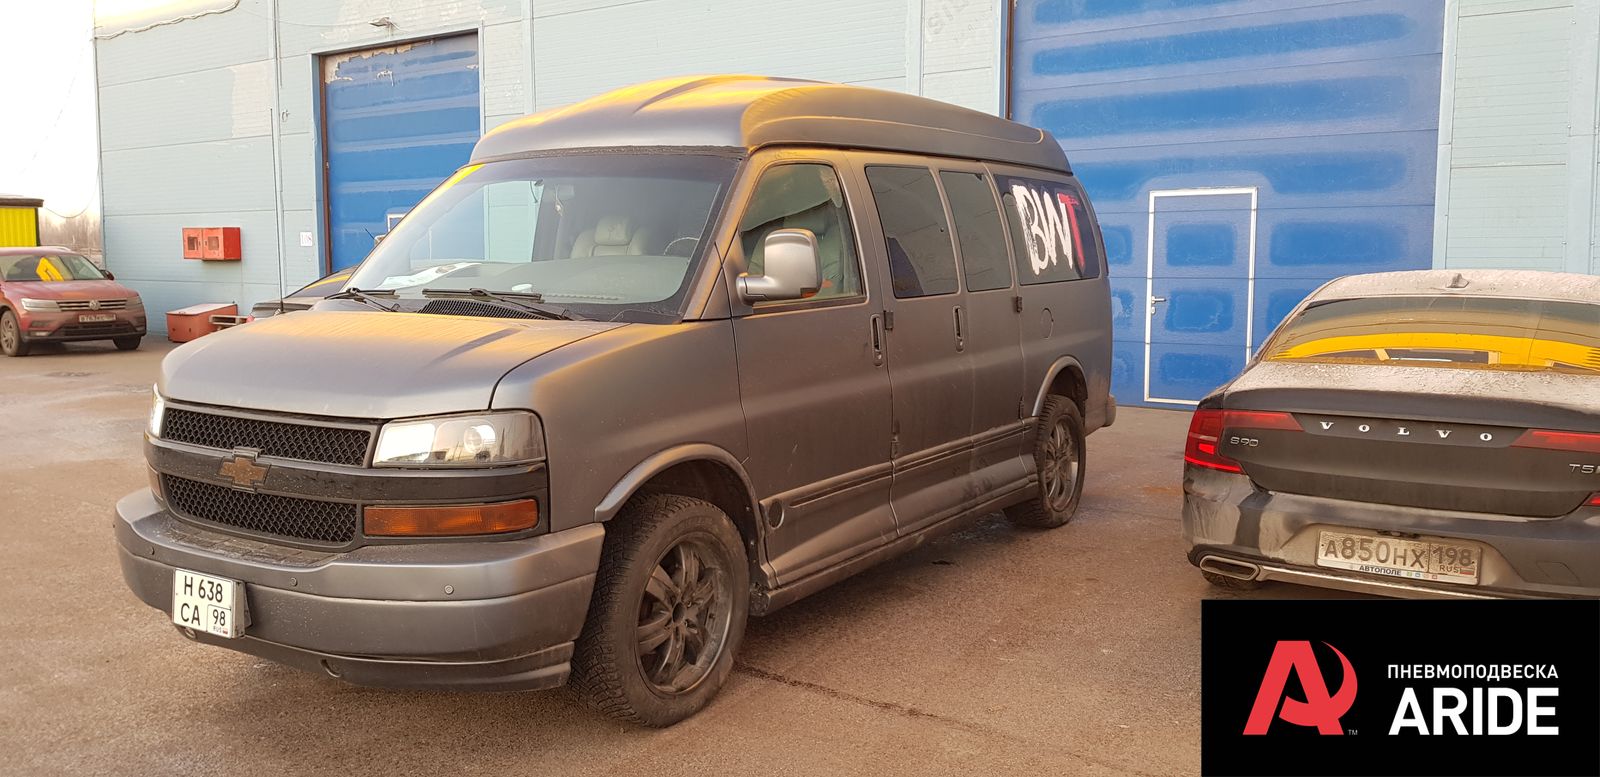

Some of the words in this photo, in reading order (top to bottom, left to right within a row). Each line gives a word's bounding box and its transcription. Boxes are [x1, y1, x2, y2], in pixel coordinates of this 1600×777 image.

[1012, 184, 1085, 275] BWT
[1320, 421, 1493, 441] VOLVO
[1230, 436, 1259, 447] S90
[1359, 565, 1401, 576] АВТОПОЛЕ
[198, 579, 223, 603] 638
[212, 609, 226, 627] 98
